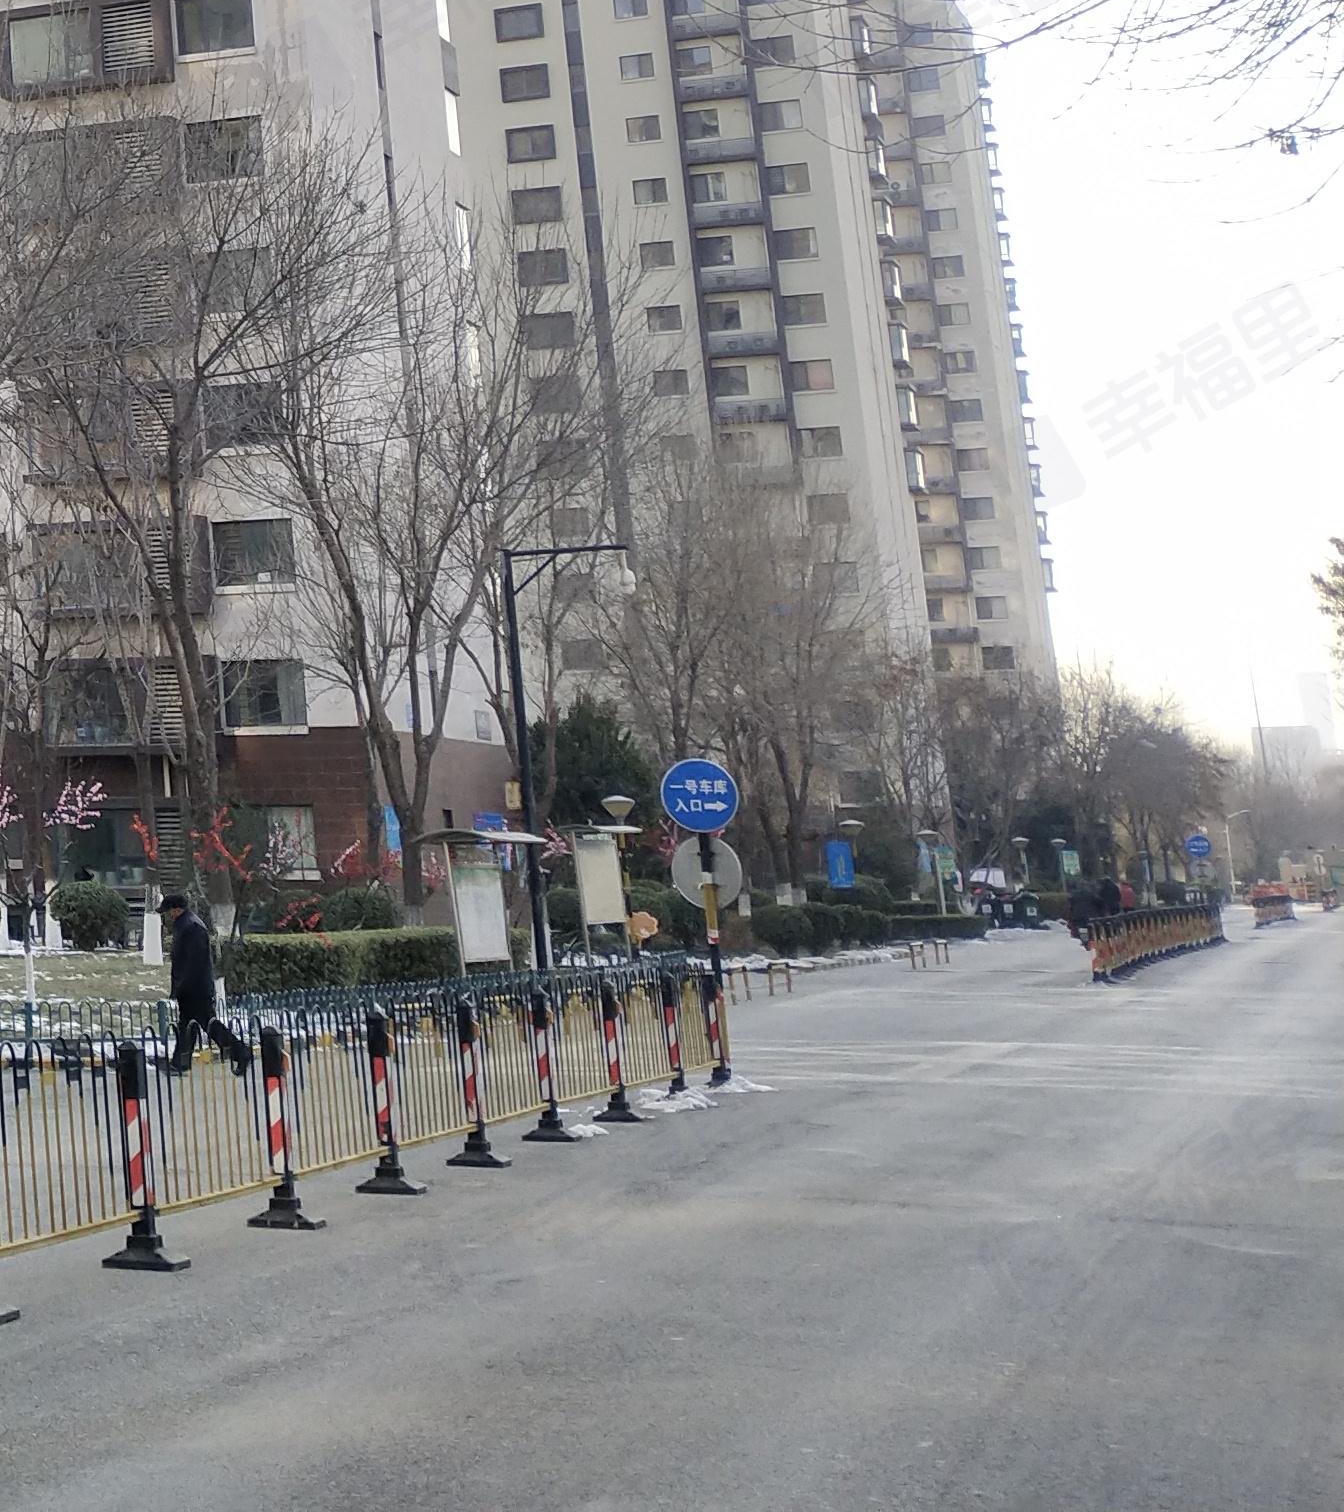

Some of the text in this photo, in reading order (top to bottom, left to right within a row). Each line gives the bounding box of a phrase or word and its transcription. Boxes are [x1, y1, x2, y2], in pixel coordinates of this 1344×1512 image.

[669, 779, 728, 795] 一号车库
[674, 798, 702, 813] 入口
